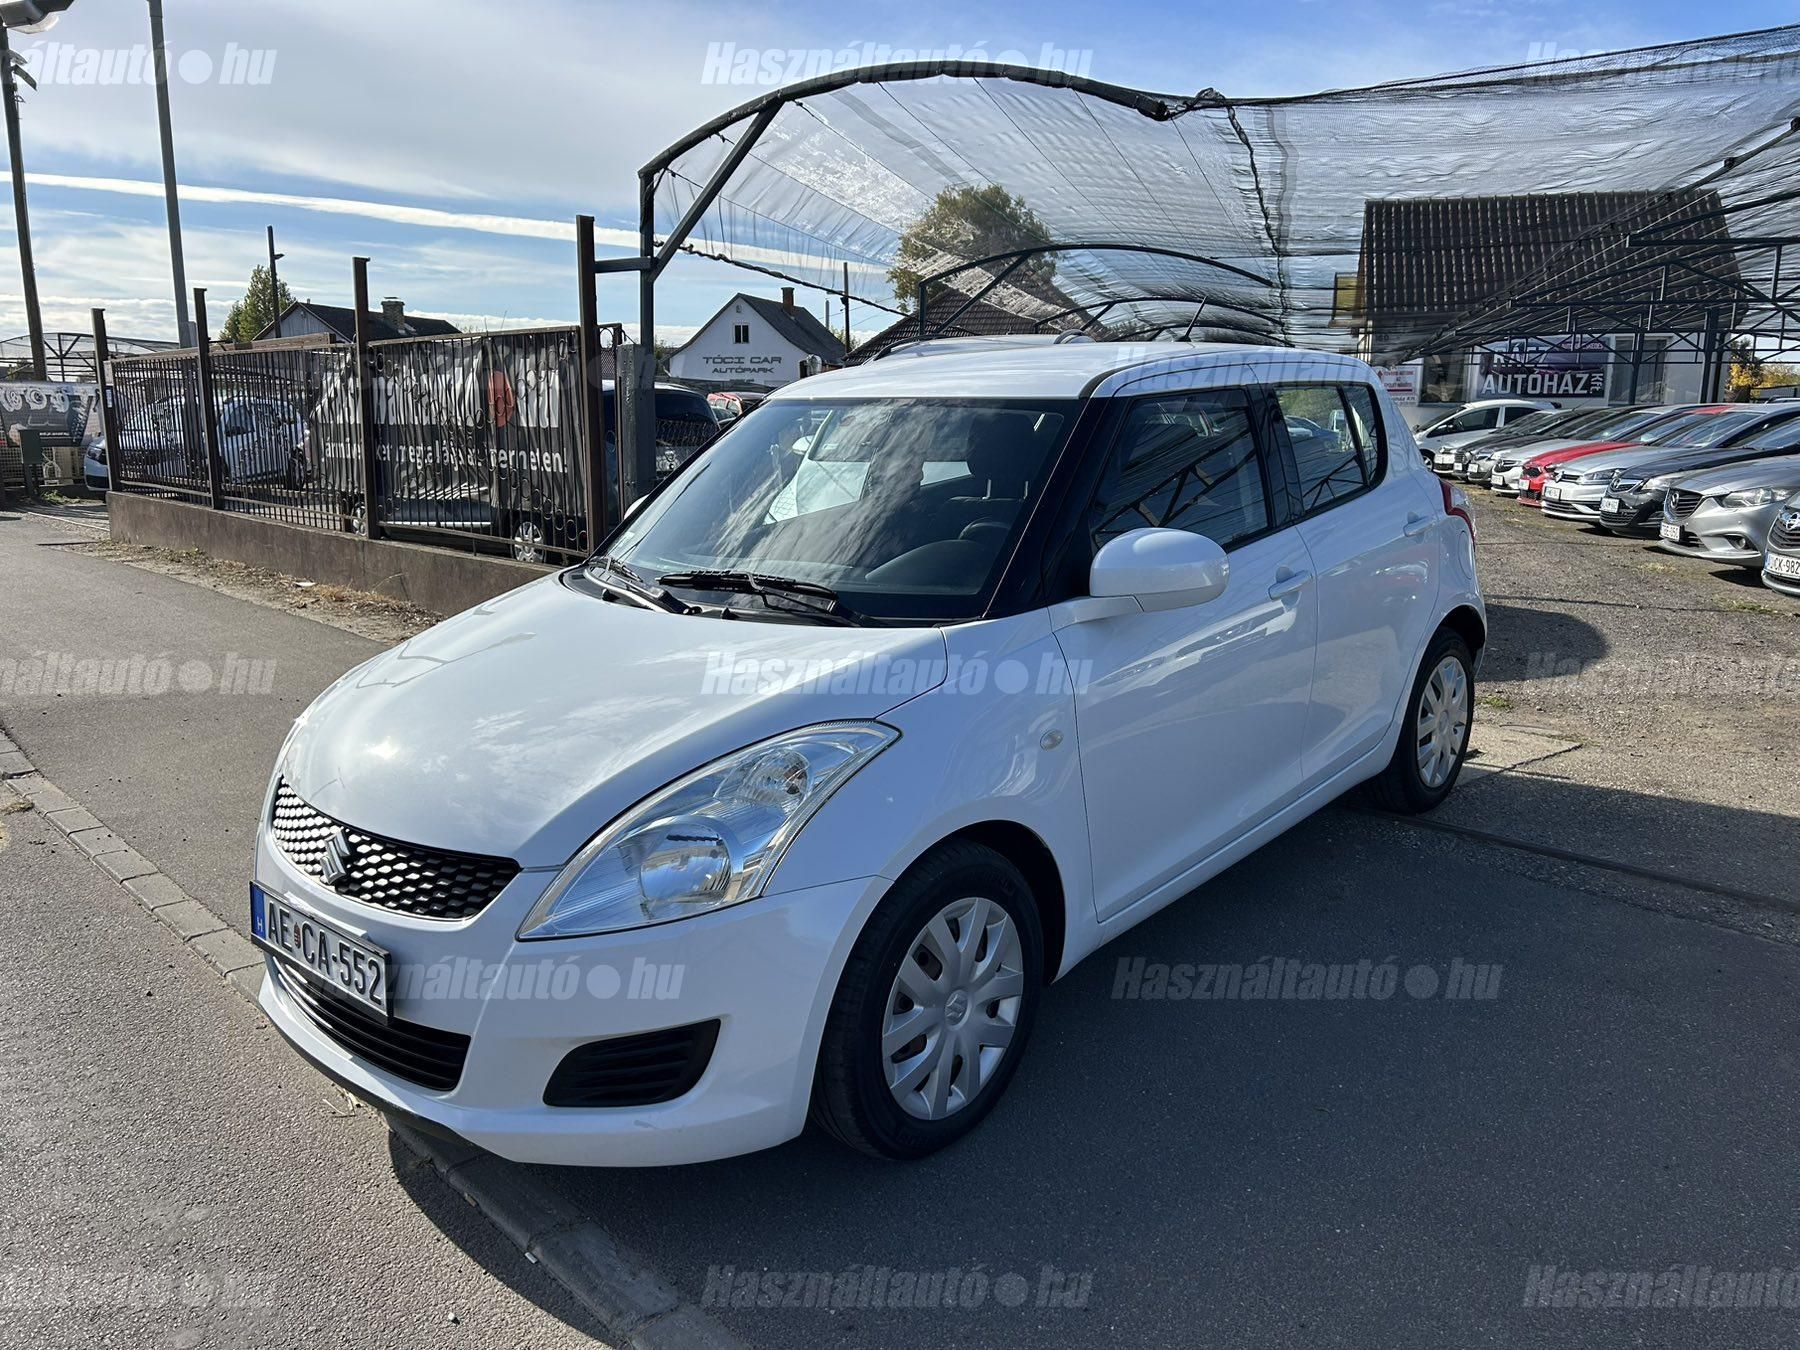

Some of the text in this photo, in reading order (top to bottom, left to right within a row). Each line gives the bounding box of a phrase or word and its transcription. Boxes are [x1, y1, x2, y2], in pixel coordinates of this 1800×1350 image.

[702, 355, 782, 364] TÓCI CAR
[712, 366, 775, 374] AUTÓPARK
[1481, 369, 1590, 394] AUTÓHÁZ
[268, 901, 293, 953] AE
[302, 921, 382, 1006] CA-552
